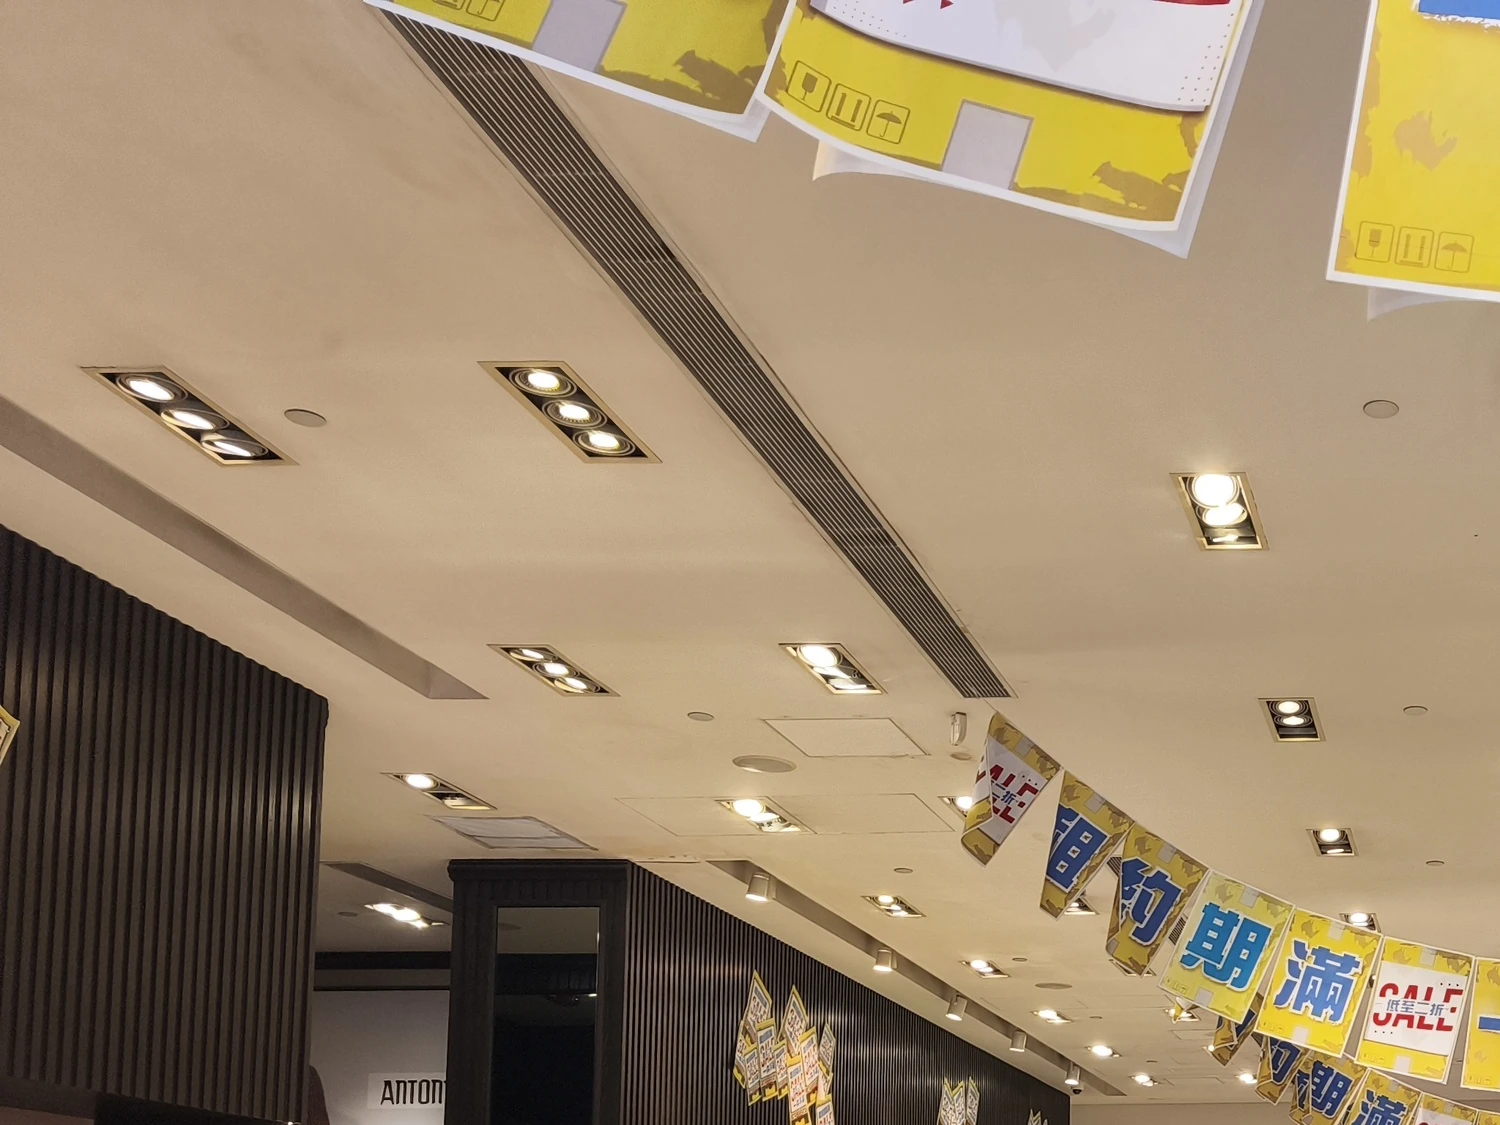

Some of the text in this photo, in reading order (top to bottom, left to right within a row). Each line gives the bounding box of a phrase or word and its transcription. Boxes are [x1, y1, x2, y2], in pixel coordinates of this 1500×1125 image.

[1373, 983, 1463, 1033] SALE
[1386, 1000, 1446, 1018] 低至二折
